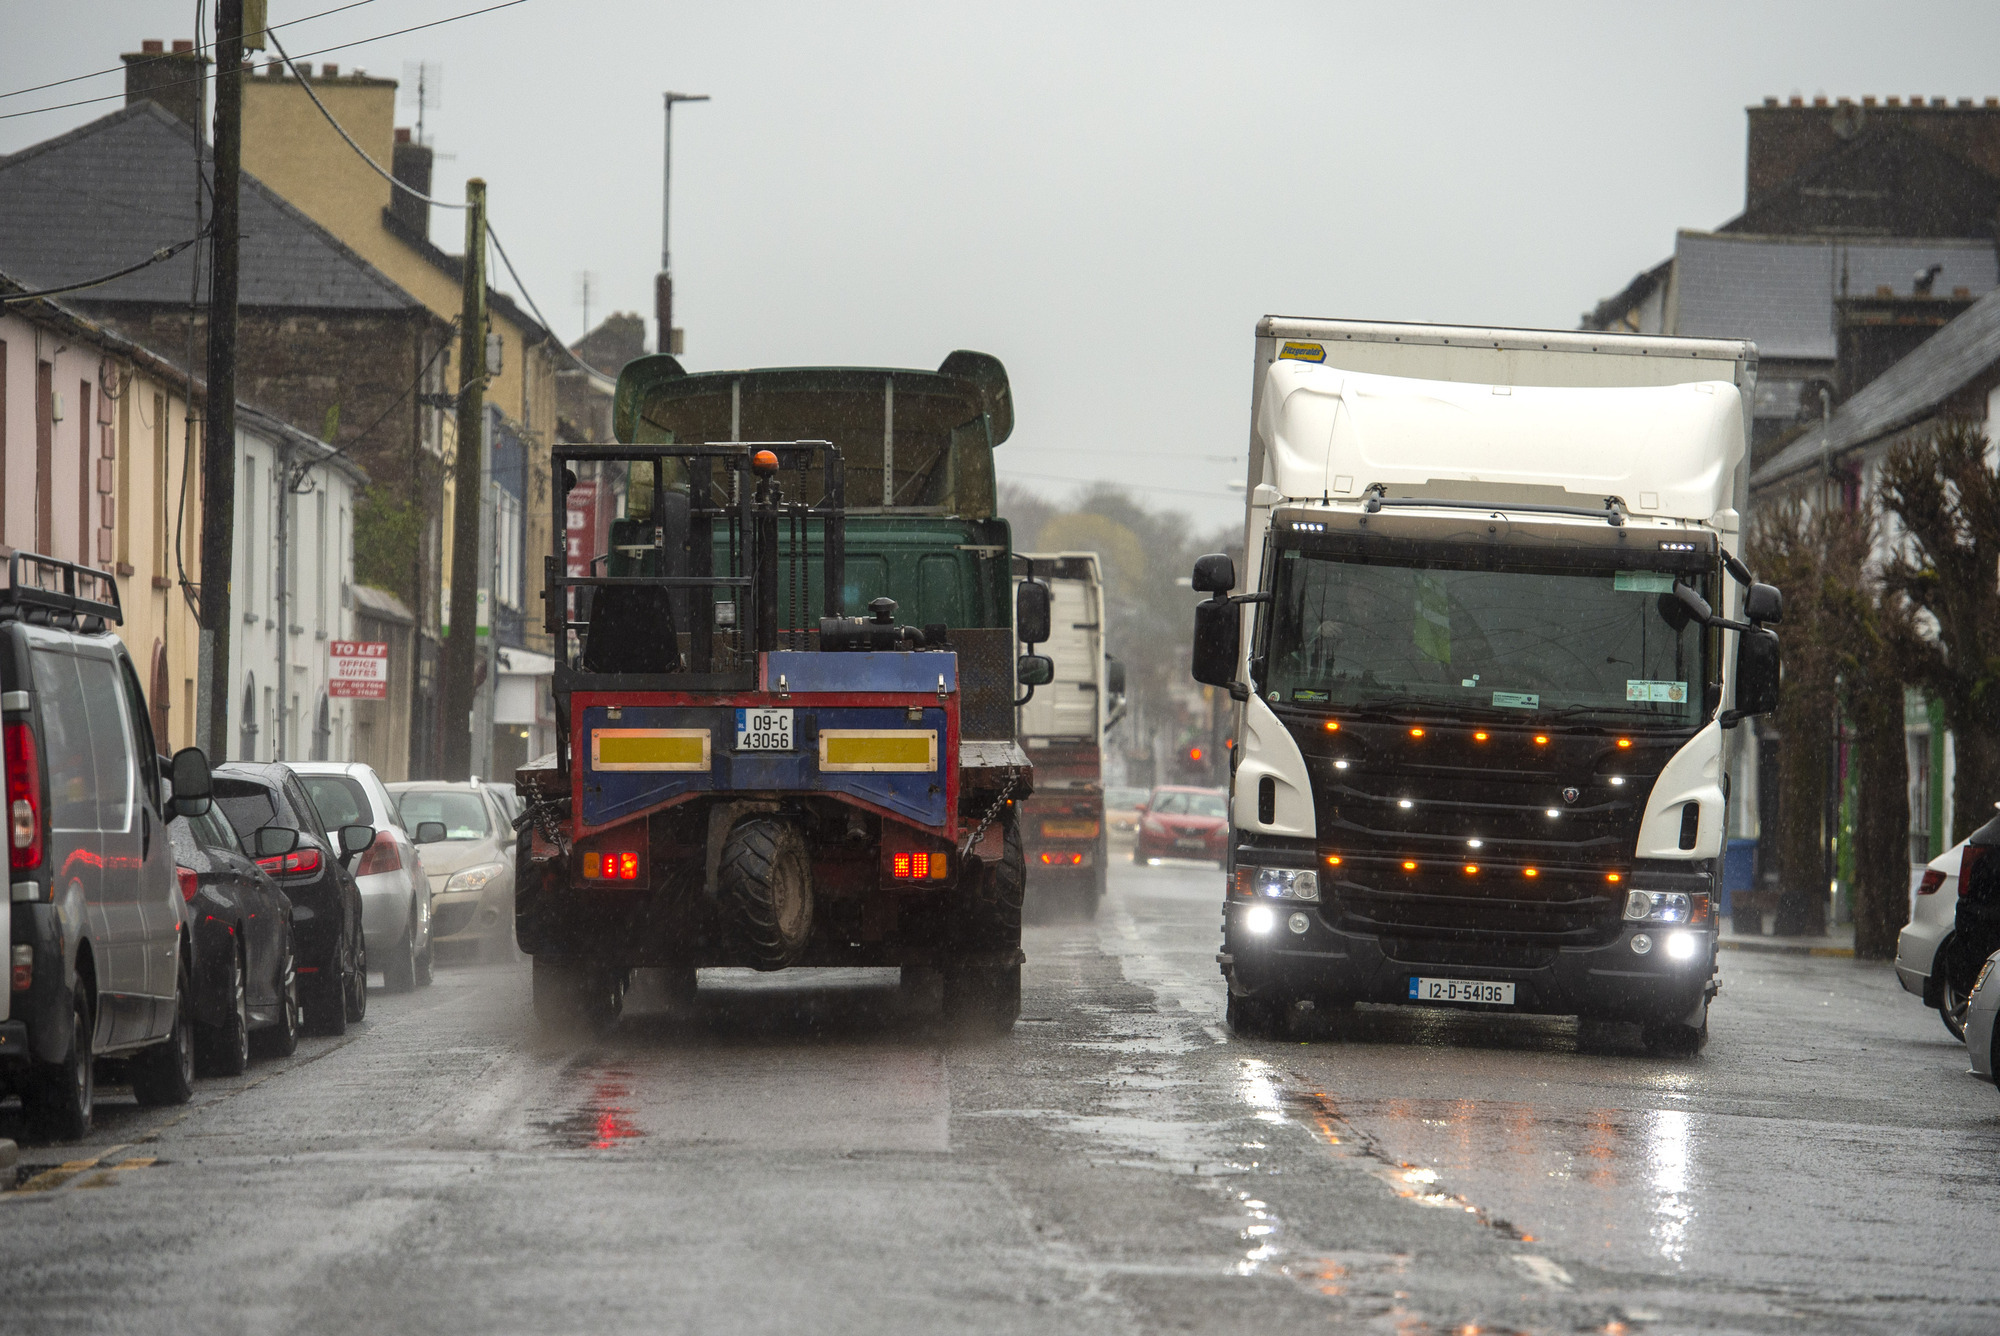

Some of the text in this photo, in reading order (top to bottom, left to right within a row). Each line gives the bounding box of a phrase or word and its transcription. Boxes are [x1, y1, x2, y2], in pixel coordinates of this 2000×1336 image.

[1282, 346, 1322, 356] Fitzgeralds
[335, 643, 386, 656] TO LET
[339, 660, 377, 668] OFFICE
[339, 669, 377, 677] SUITES
[753, 715, 788, 731] 09-C
[743, 733, 789, 748] 43056
[1429, 982, 1502, 1002] 12-D-54136
